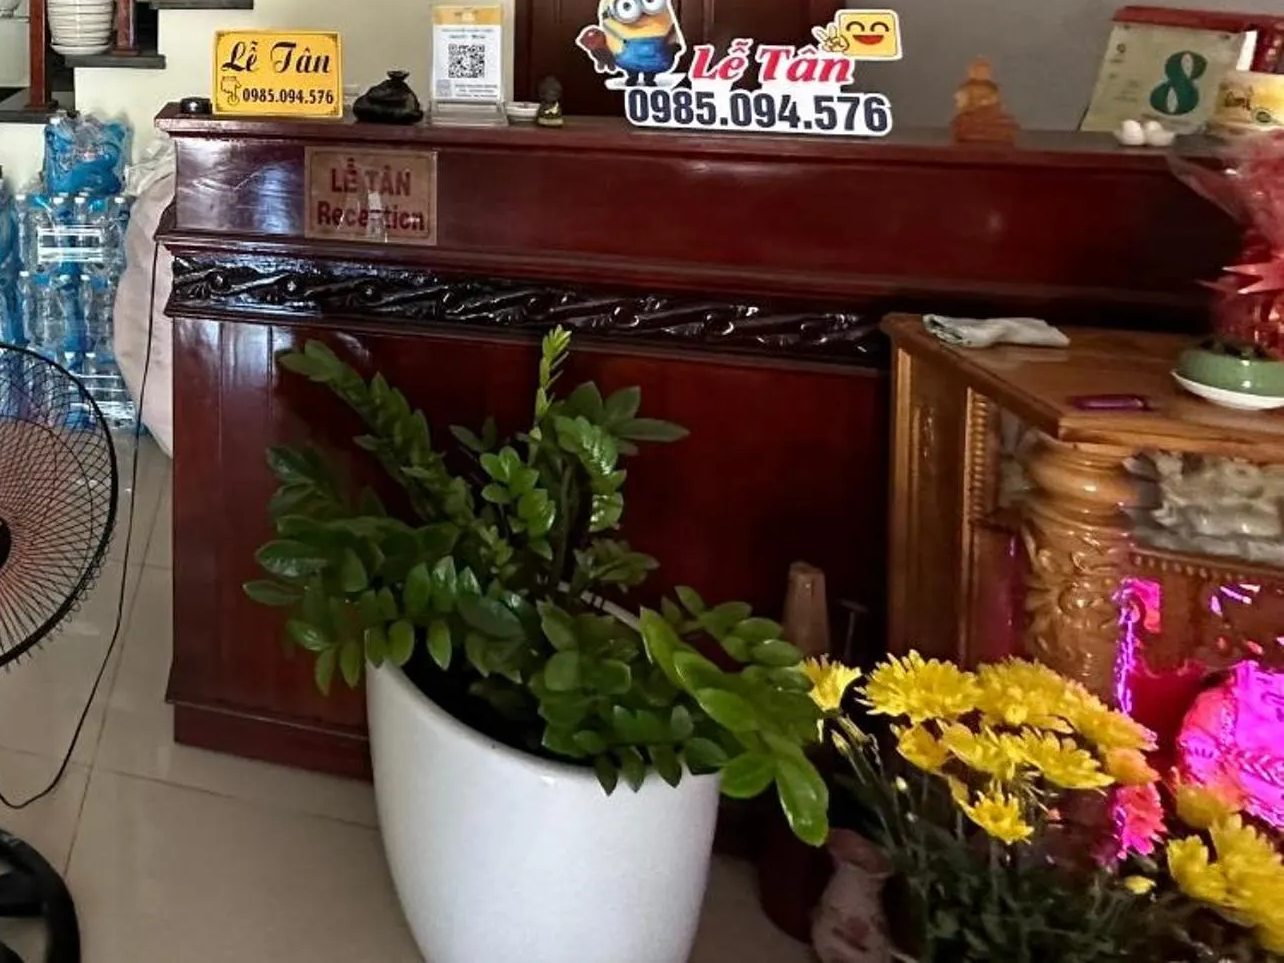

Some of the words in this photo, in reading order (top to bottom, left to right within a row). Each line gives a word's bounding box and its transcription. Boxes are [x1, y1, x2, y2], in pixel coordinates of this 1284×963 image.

[221, 41, 259, 72] Lễ
[270, 41, 330, 73] Tân
[692, 39, 752, 81] Lễ
[758, 46, 851, 83] Tân
[242, 88, 334, 105] 0985.094.576
[1149, 50, 1208, 116] 8
[628, 89, 888, 132] 0985.094.576
[331, 157, 357, 193] LỄ
[366, 164, 411, 196] TÂN
